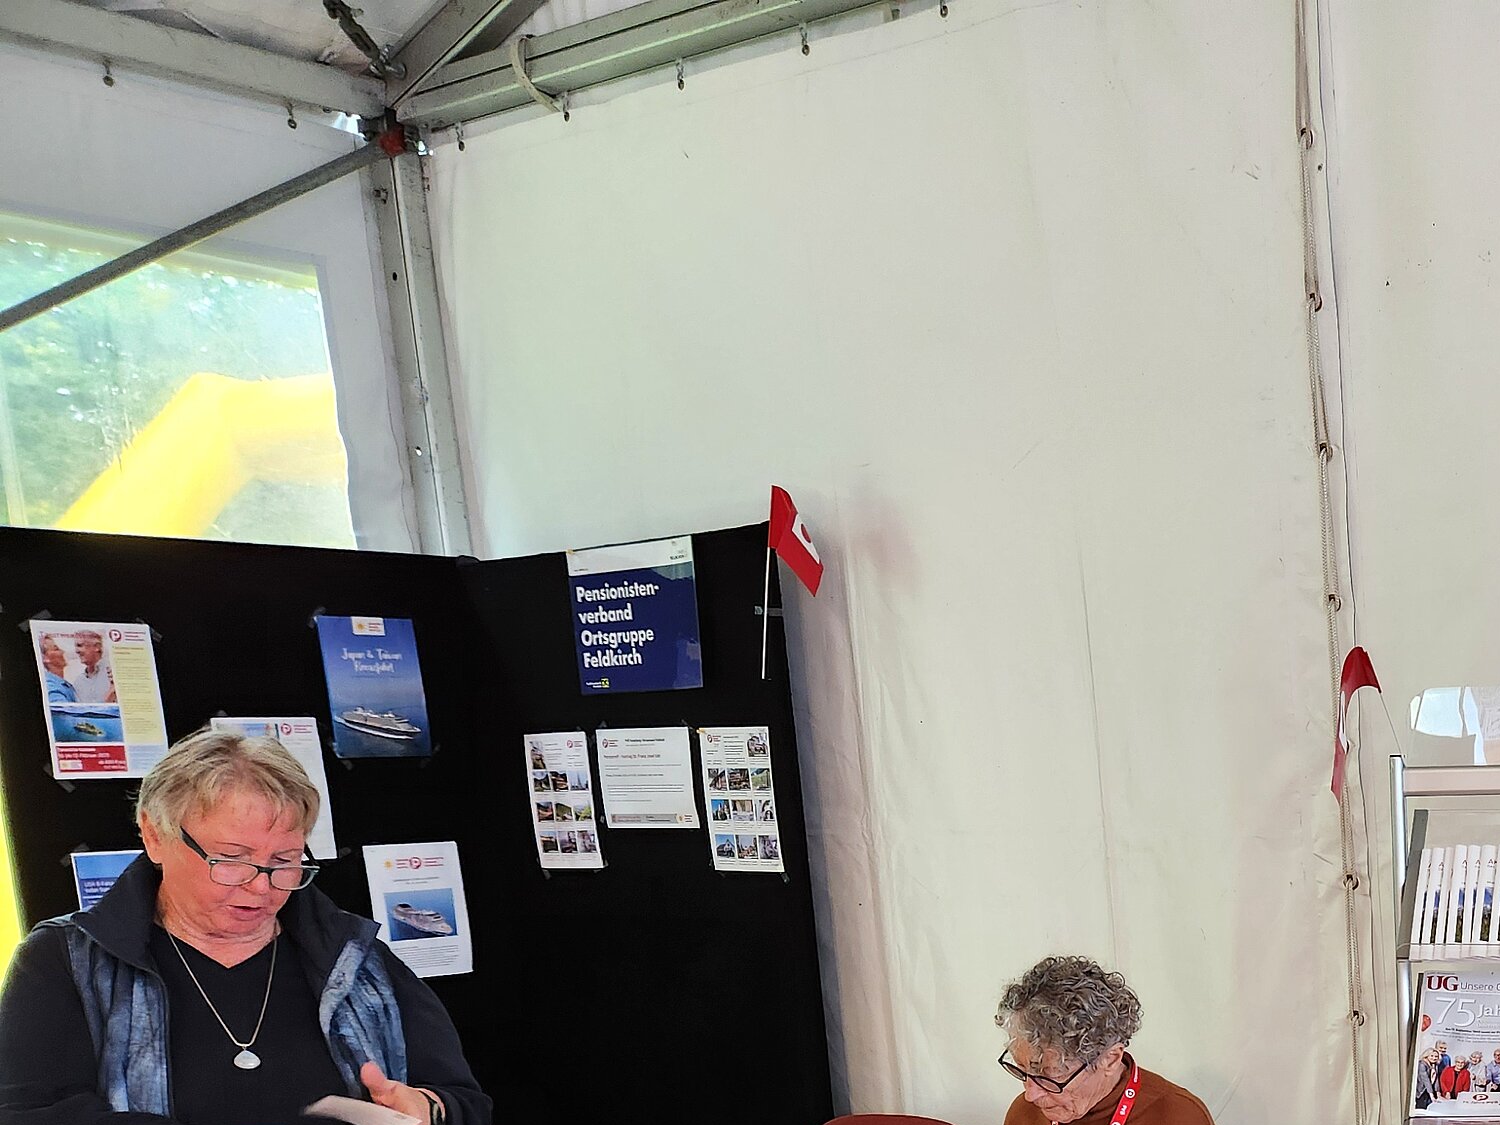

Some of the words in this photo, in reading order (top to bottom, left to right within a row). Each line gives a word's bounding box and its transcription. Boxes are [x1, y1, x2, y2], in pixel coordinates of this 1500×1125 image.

[575, 580, 660, 603] Pensionisten-
[577, 602, 633, 624] verband
[580, 629, 655, 649] Ortsgruppe
[582, 647, 643, 668] Feldkirch
[1426, 975, 1459, 992] UG
[1460, 982, 1494, 991] Unsere
[1435, 996, 1477, 1028] 75
